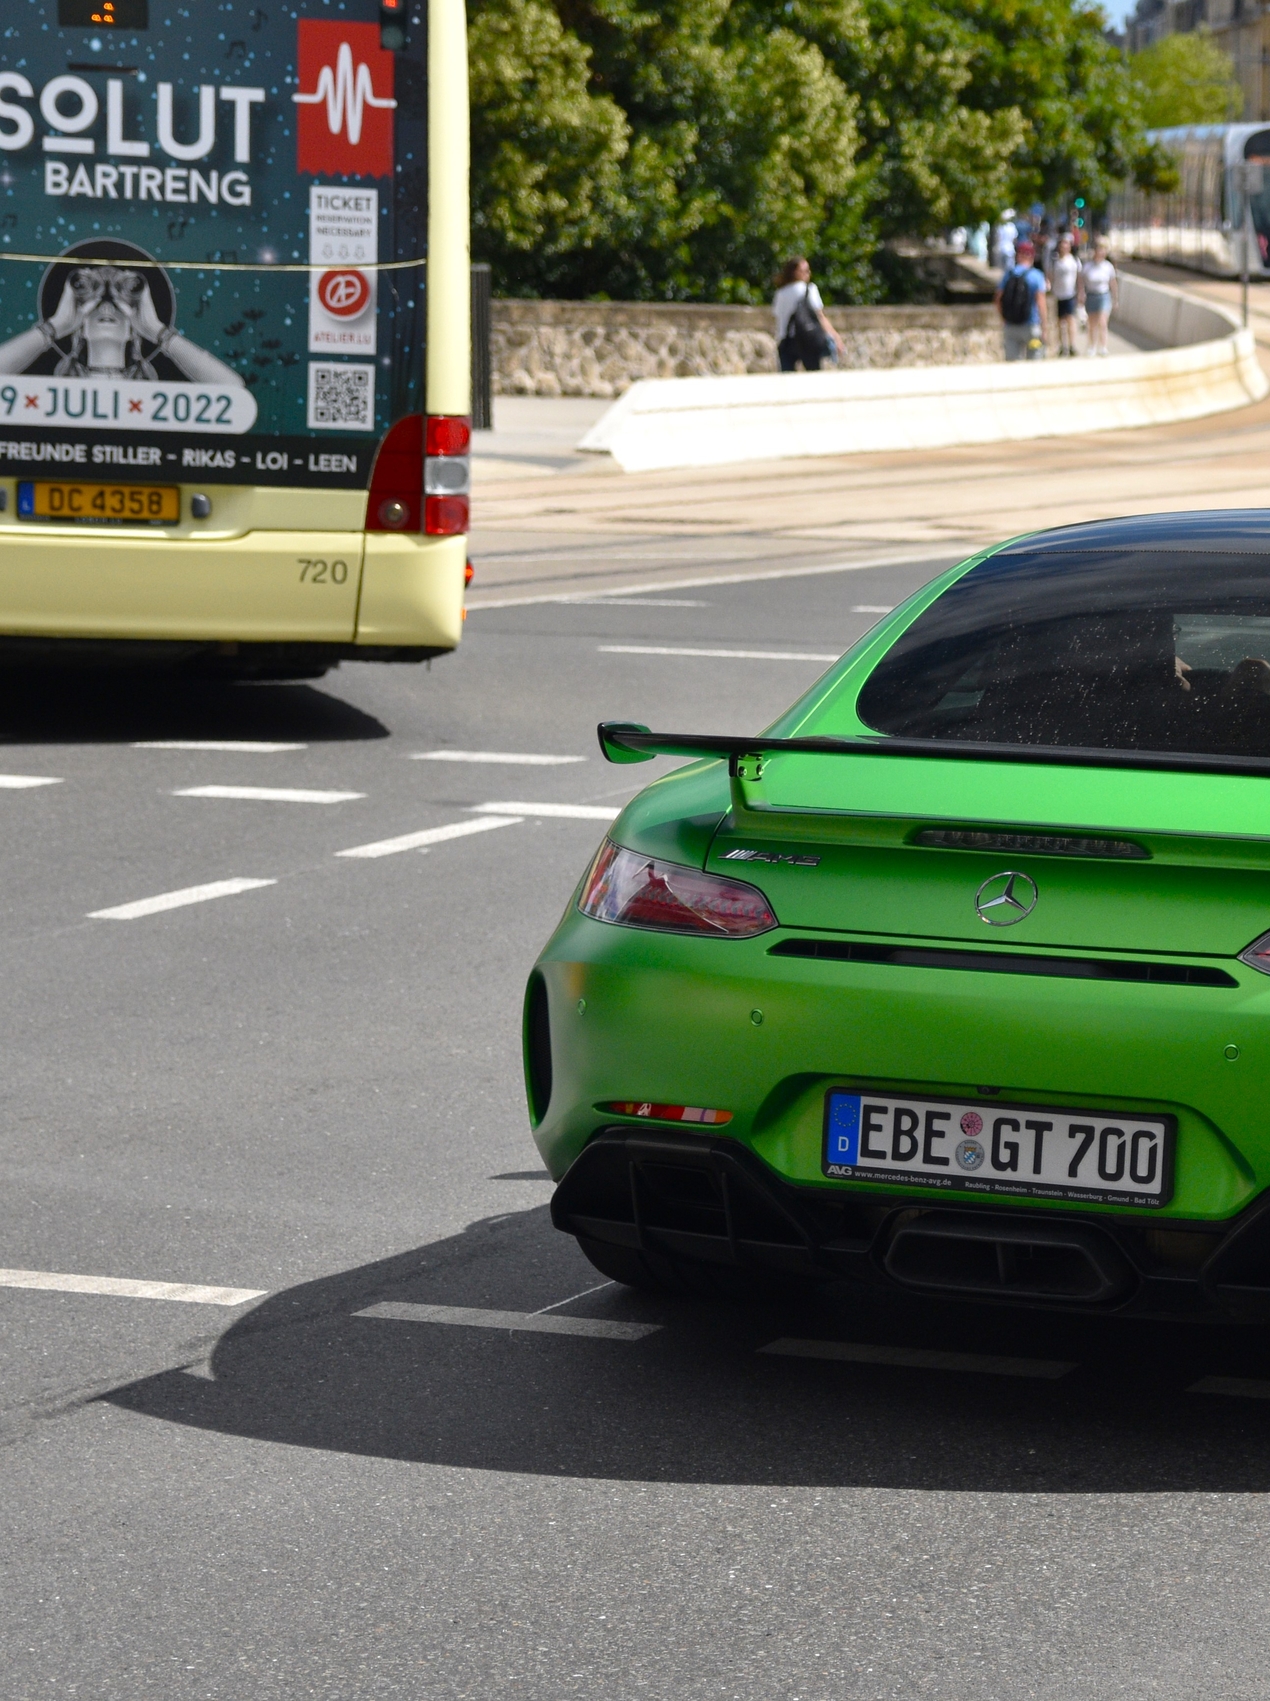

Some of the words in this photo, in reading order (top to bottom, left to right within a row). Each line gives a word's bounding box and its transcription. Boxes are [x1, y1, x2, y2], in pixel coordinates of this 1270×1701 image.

[45, 160, 252, 206] BARTRENG
[316, 194, 373, 211] TICKET
[316, 214, 373, 225] RESERVATION
[316, 226, 372, 238] NECESSARY
[314, 331, 371, 345] ATELIER.LU
[44, 386, 119, 420] JULI
[151, 391, 233, 425] 2022
[0, 440, 87, 463] FREUNDE
[92, 445, 162, 466] STILLER
[182, 448, 236, 470] RIKAS
[256, 451, 288, 471] LOI
[308, 453, 357, 473] LEEN
[22, 500, 31, 511] L
[50, 487, 83, 512] DC
[91, 489, 163, 515] 4358
[297, 559, 348, 584] 720
[749, 851, 822, 867] AMG
[838, 1136, 849, 1152] D
[859, 1103, 952, 1167] EBE
[991, 1117, 1053, 1175] GT
[1067, 1123, 1158, 1185] 700
[827, 1165, 853, 1176] AVG
[854, 1171, 952, 1187] www.mercedes-benz-avg.de
[965, 1181, 990, 1191] Raubling
[995, 1184, 1027, 1194] Rosenheim
[1032, 1188, 1064, 1197] Traunstein
[1067, 1191, 1103, 1201] Wasserburg
[1134, 1197, 1146, 1205] Bad
[1147, 1198, 1160, 1206] Tölz
